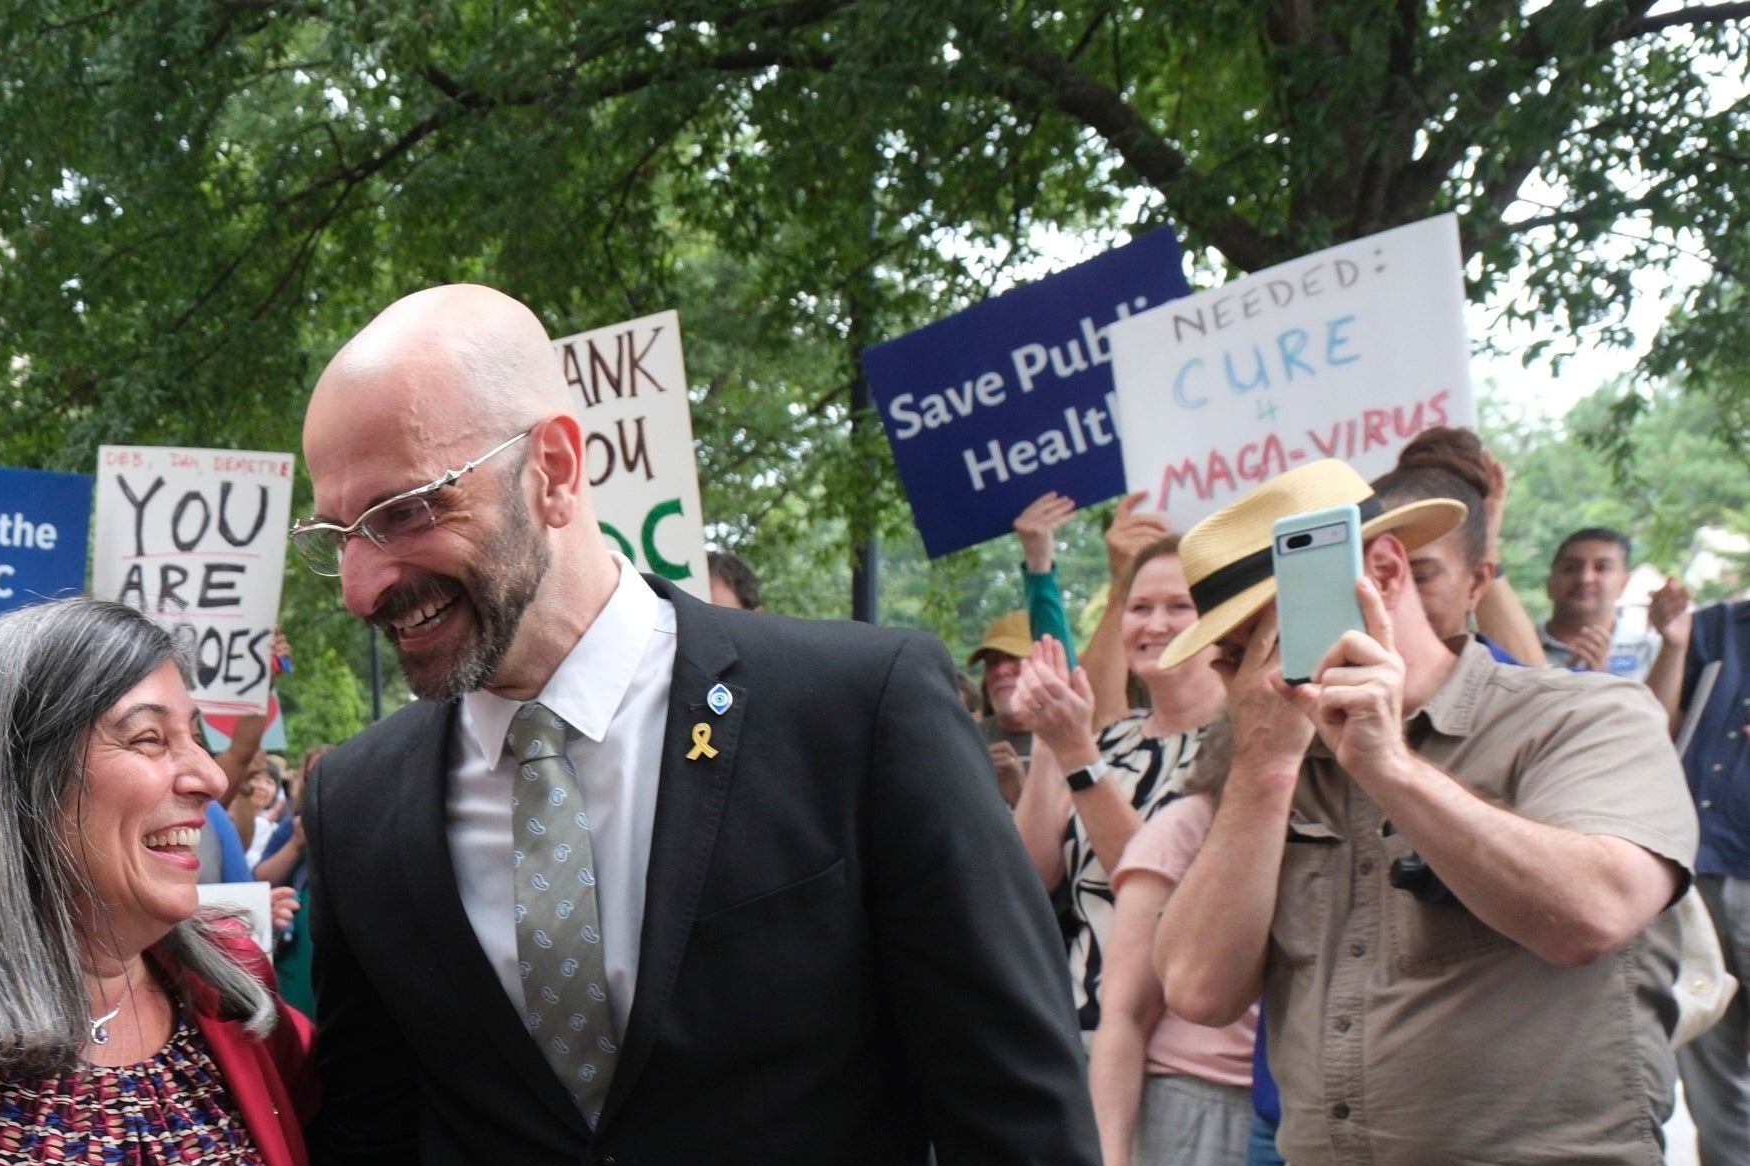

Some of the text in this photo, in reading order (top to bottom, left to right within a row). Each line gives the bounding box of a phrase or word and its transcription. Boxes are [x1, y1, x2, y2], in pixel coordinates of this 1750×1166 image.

[1172, 247, 1387, 343] NEEDED:
[553, 326, 667, 408] ANK
[887, 296, 1149, 441] Save Pub
[1172, 315, 1362, 410] CURE
[585, 415, 655, 487] OU
[1157, 389, 1450, 512] MAGA-VIRUS
[1256, 399, 1281, 422] 4
[115, 473, 271, 558] YOU
[117, 561, 247, 614] ARE
[173, 622, 272, 696] ROES
